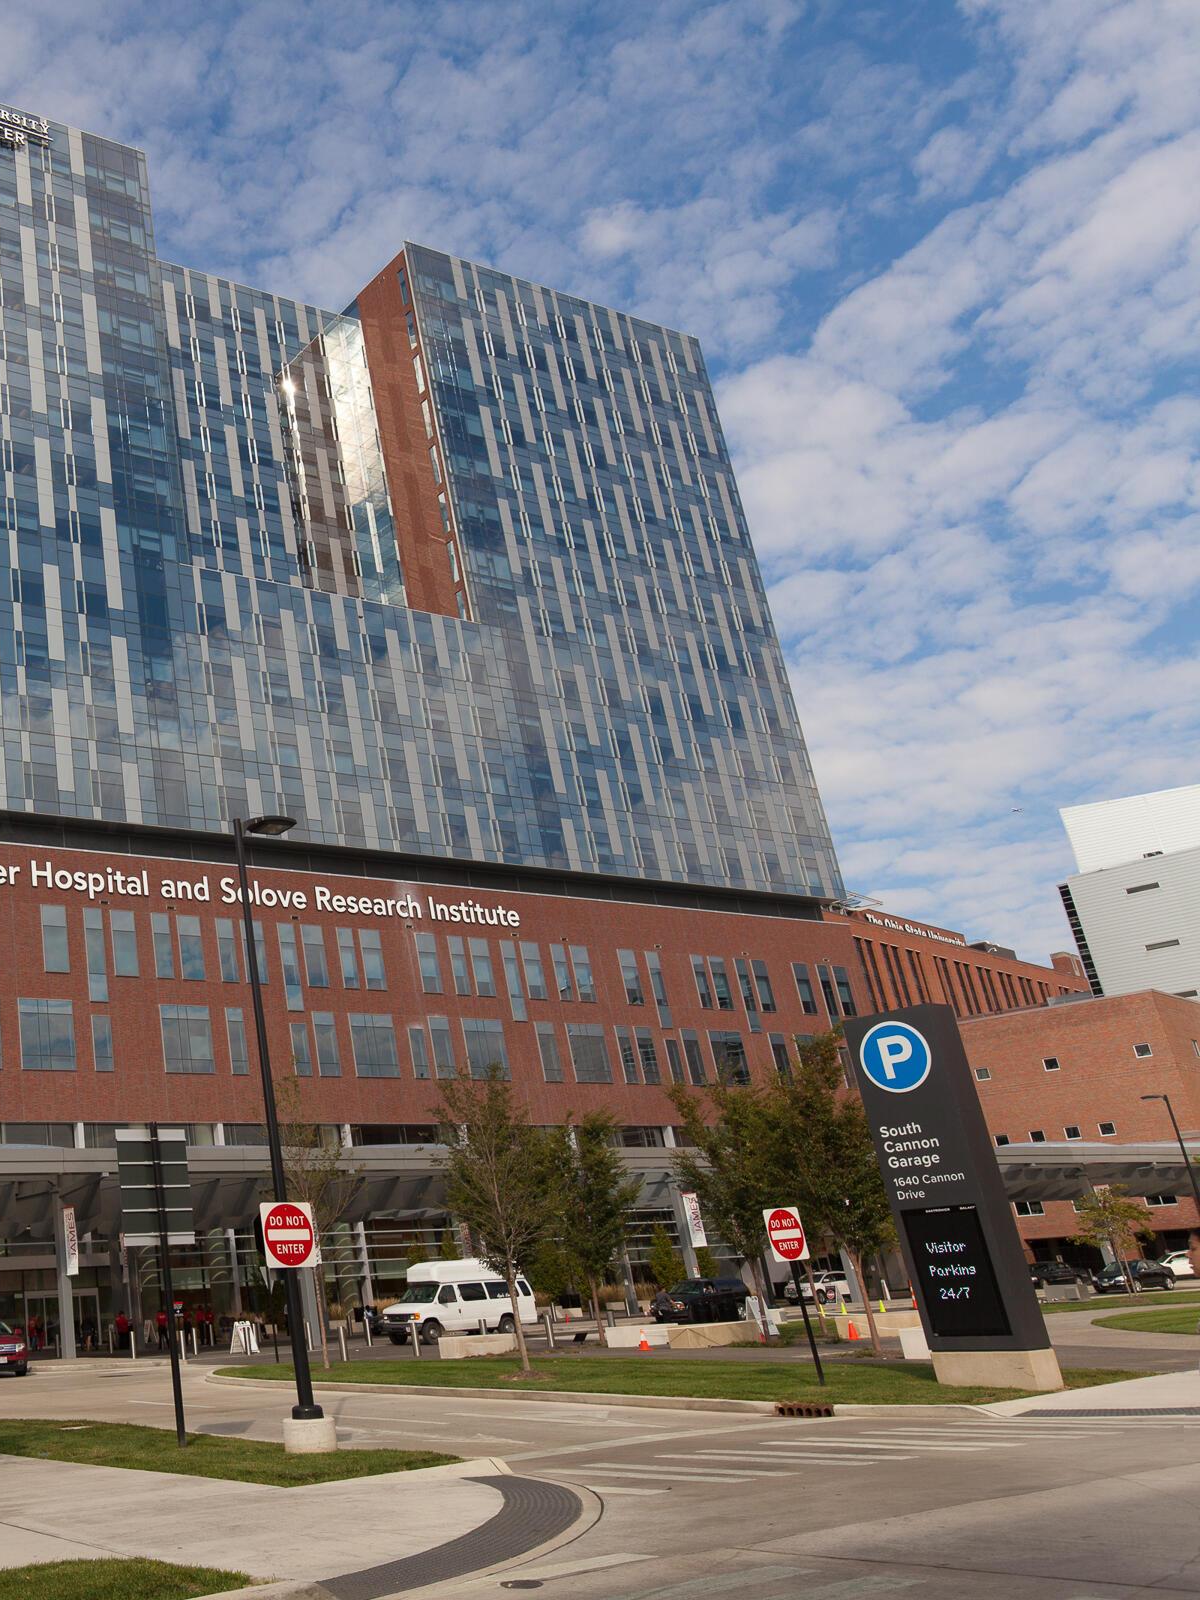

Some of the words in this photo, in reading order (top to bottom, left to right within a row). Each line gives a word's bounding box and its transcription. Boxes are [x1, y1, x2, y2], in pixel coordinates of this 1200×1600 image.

[30, 860, 149, 900] Hospital
[160, 876, 210, 902] and
[220, 877, 307, 910] Solove
[314, 886, 423, 920] Research
[428, 895, 521, 928] Institute
[876, 1034, 913, 1080] P
[880, 1121, 922, 1138] South
[884, 1137, 940, 1153] Cannon
[887, 1154, 940, 1169] Garage
[893, 1175, 920, 1187] 1640
[922, 1172, 965, 1184] Cannon
[896, 1190, 926, 1201] Drive
[269, 1216, 284, 1227] DO
[286, 1214, 305, 1226] NOT
[689, 1196, 704, 1232] JAMES
[770, 1218, 781, 1229] DO
[782, 1217, 796, 1228] NOT
[68, 1212, 77, 1256] JAMES
[276, 1243, 306, 1255] ENTER
[778, 1240, 800, 1251] ENTER
[925, 1241, 967, 1254] Visitor
[929, 1263, 977, 1277] Parking
[939, 1286, 970, 1300] 24/7
